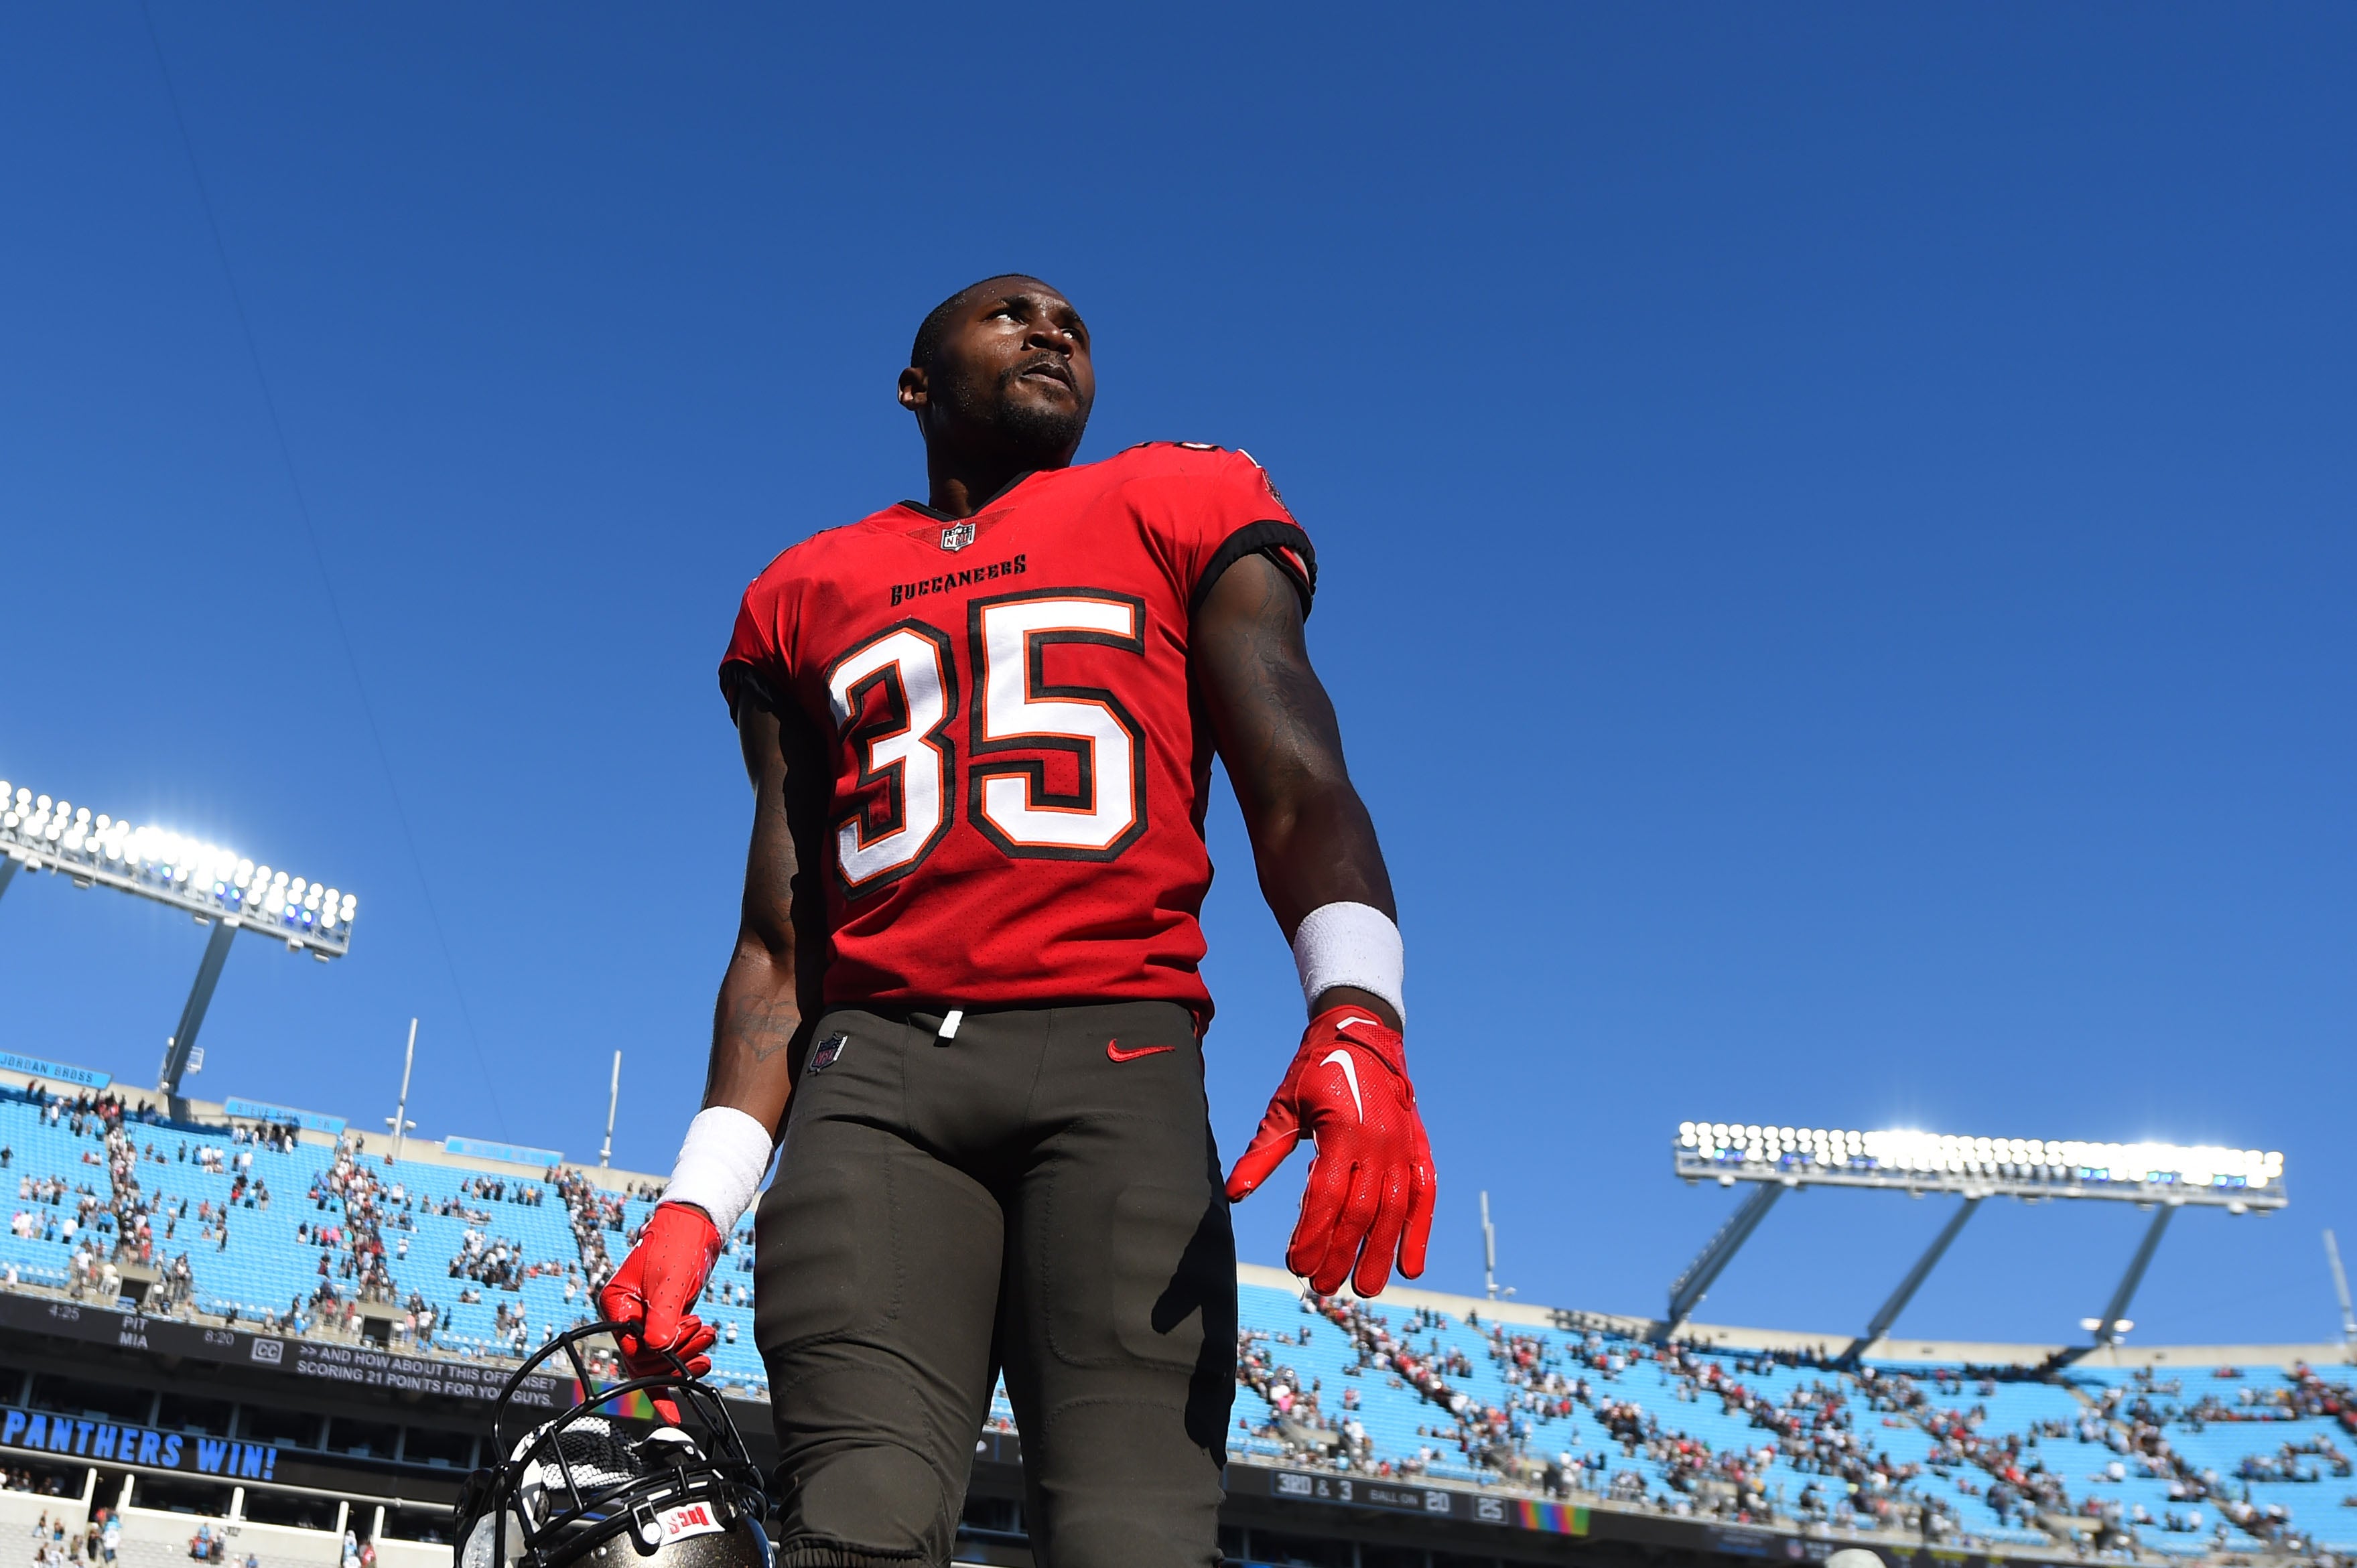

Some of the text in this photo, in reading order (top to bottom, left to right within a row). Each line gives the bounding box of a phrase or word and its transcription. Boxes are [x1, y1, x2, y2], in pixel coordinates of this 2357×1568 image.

[890, 554, 1026, 607] BUCCANEERS
[827, 587, 1147, 901] 35
[0, 1054, 48, 1073] JORDAN
[49, 1304, 80, 1322] 4:25
[121, 1316, 149, 1332] PIT
[118, 1331, 148, 1349] MIA
[204, 1330, 234, 1346] 8:20
[320, 1348, 351, 1363] AND
[354, 1352, 389, 1369] HOW
[389, 1356, 444, 1376] ABOUT
[447, 1366, 480, 1382] THIS
[483, 1370, 557, 1391] OFFNSE?
[296, 1361, 363, 1382] SCORING
[367, 1370, 383, 1384] 21
[386, 1373, 441, 1393] POINTS
[444, 1382, 474, 1397] FOR
[513, 1389, 553, 1407] GUYS.
[2, 1411, 277, 1480] PANTHERS WIN!
[1339, 1480, 1353, 1502] 3
[1369, 1489, 1398, 1504] BALL
[1425, 1491, 1451, 1513] 20
[1479, 1498, 1503, 1520] 25
